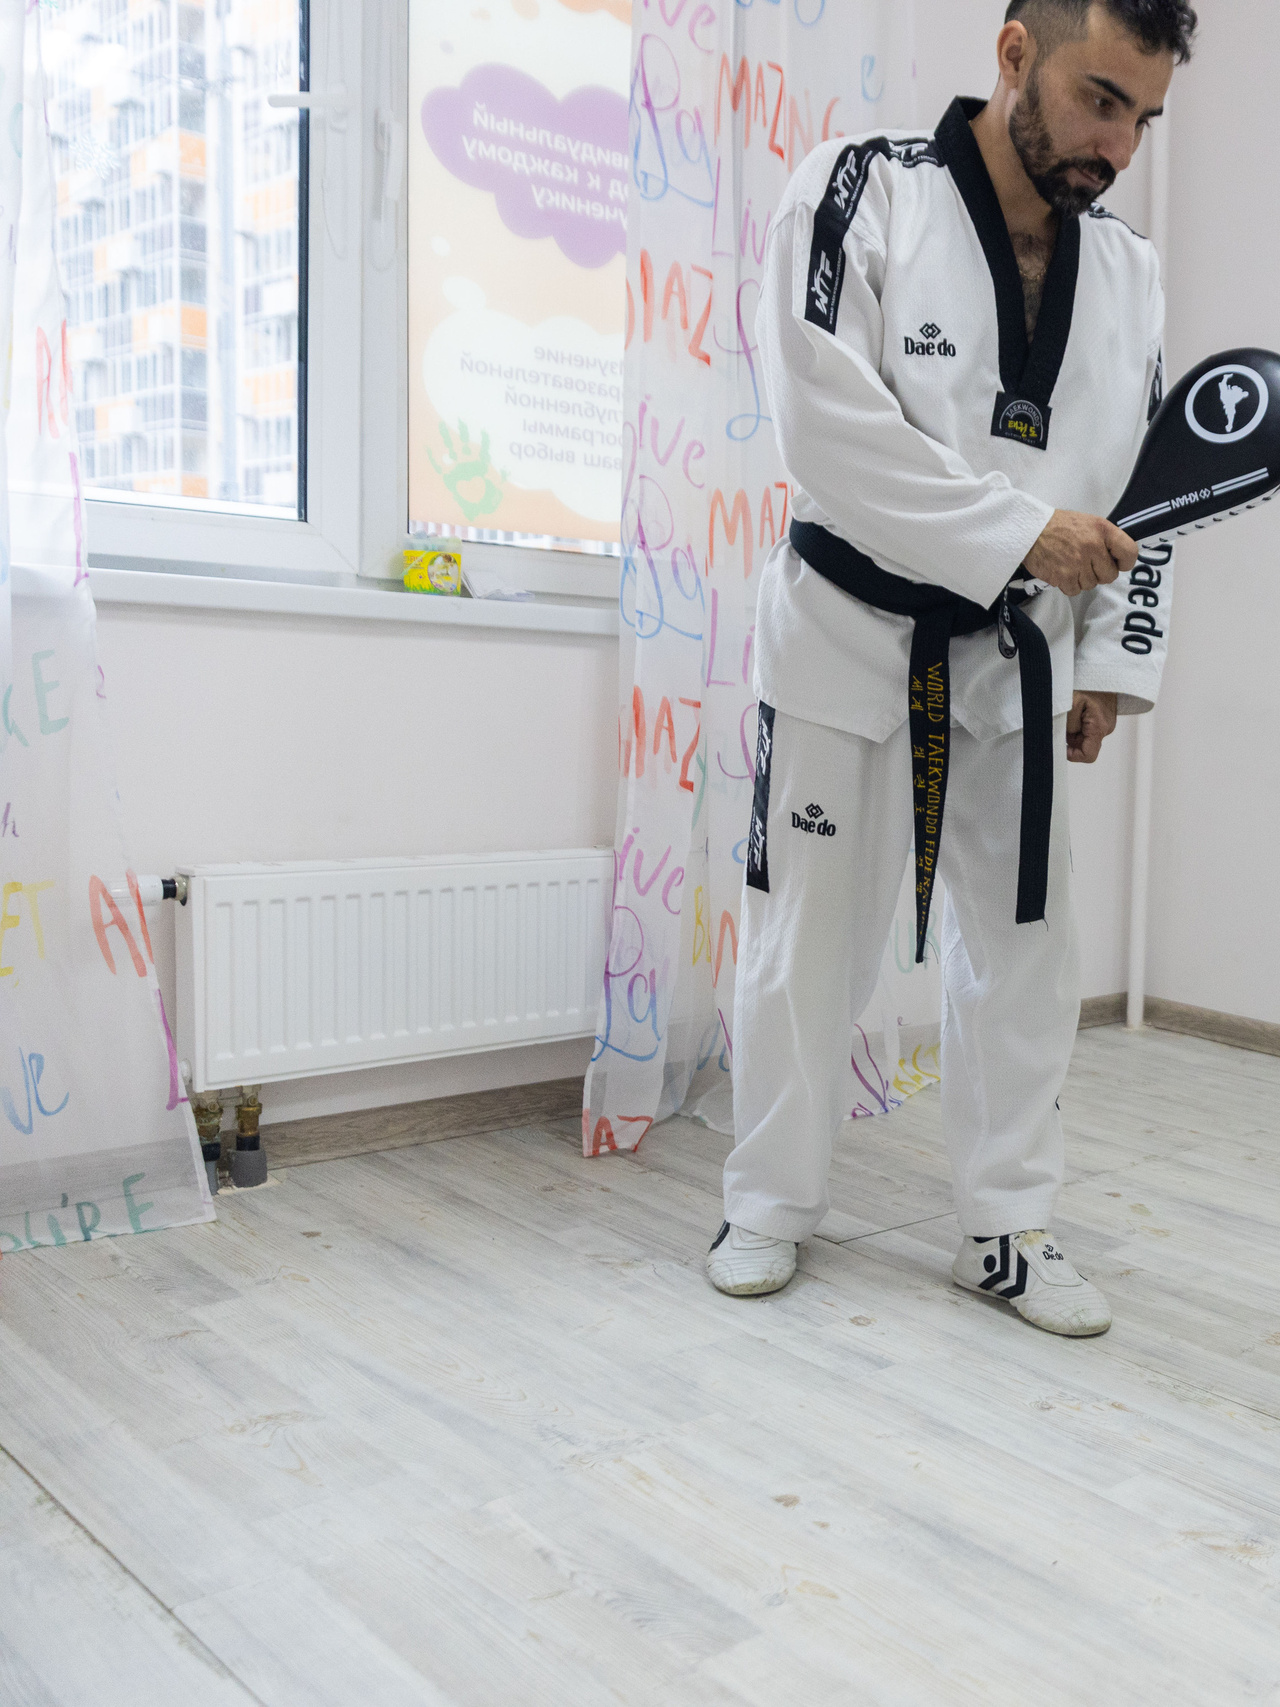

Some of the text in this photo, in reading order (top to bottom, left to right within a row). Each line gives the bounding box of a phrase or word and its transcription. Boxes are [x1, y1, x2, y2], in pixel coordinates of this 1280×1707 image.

[1005, 403, 1040, 428] TAEKWONDO
[926, 661, 945, 723] WORLD
[925, 732, 945, 834] TAEKWONDO
